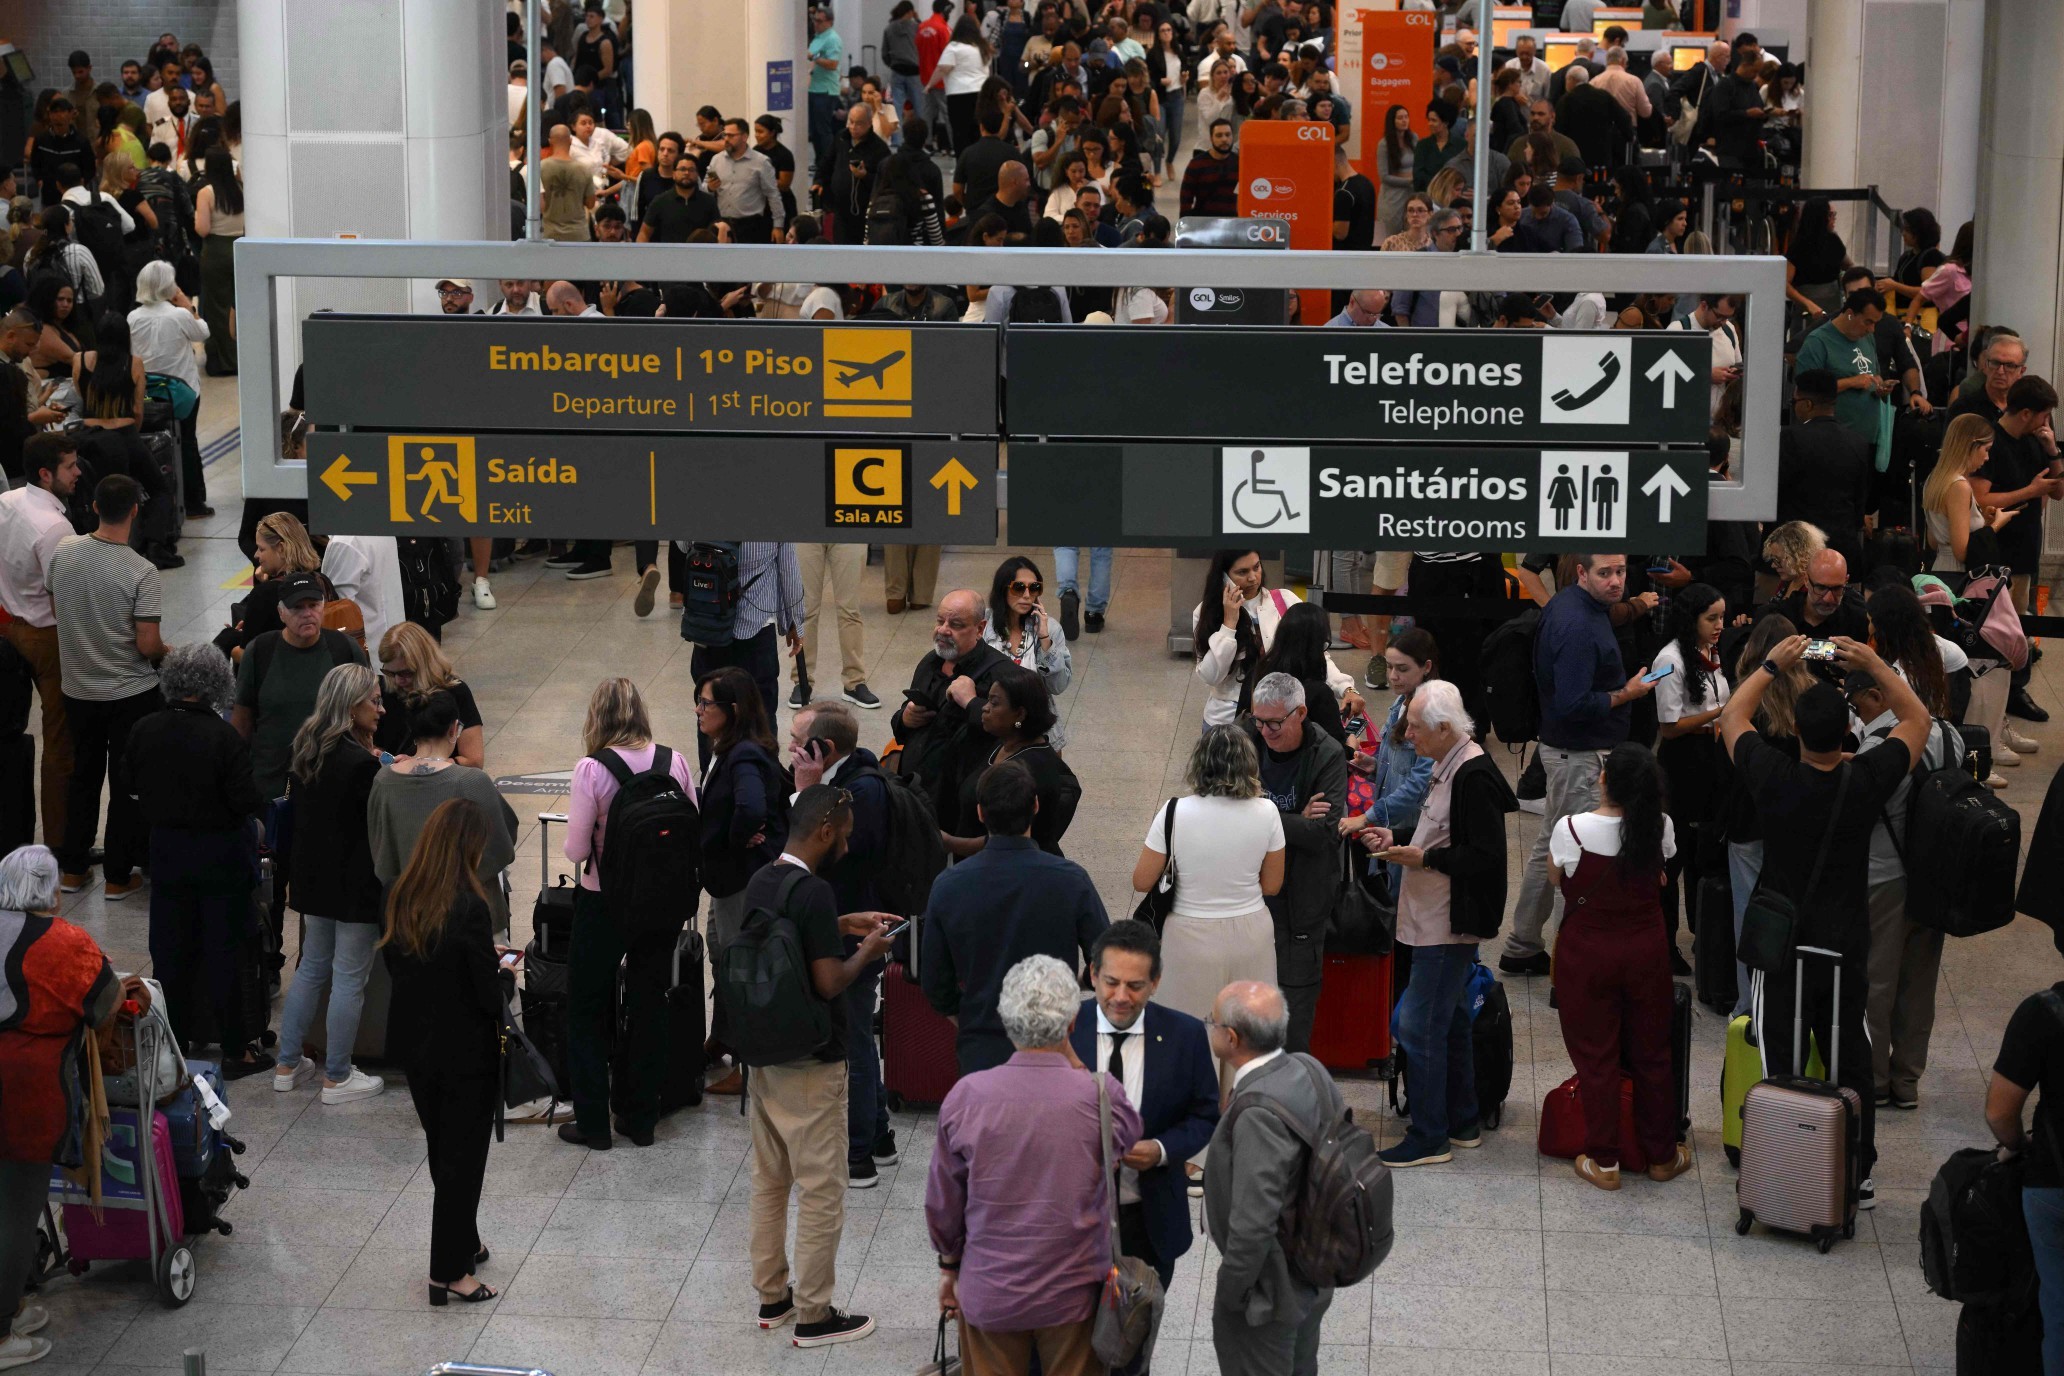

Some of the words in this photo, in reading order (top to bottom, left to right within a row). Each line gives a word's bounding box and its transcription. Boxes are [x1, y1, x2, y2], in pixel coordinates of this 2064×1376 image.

[1405, 14, 1431, 25] GOL
[1371, 78, 1411, 87] Bagagem
[1297, 126, 1331, 141] GOL
[1246, 225, 1285, 243] GOL
[1193, 294, 1212, 302] GOL
[1219, 294, 1241, 303] Smiles
[490, 345, 661, 379] Embarque
[699, 349, 734, 374] 1º
[746, 349, 813, 376] Piso
[1323, 352, 1523, 387] Telefones
[552, 392, 677, 419] Departure
[709, 391, 741, 416] 1st
[750, 395, 813, 417] Floor
[1379, 399, 1525, 430] Telephone
[487, 457, 577, 484] Saída
[852, 457, 885, 497] C
[1319, 466, 1528, 501] Sanitários
[489, 502, 533, 524] Exit
[834, 509, 870, 523] Sala
[875, 510, 903, 524] AIS
[1379, 513, 1527, 539] Restrooms
[693, 579, 713, 589] LiveU
